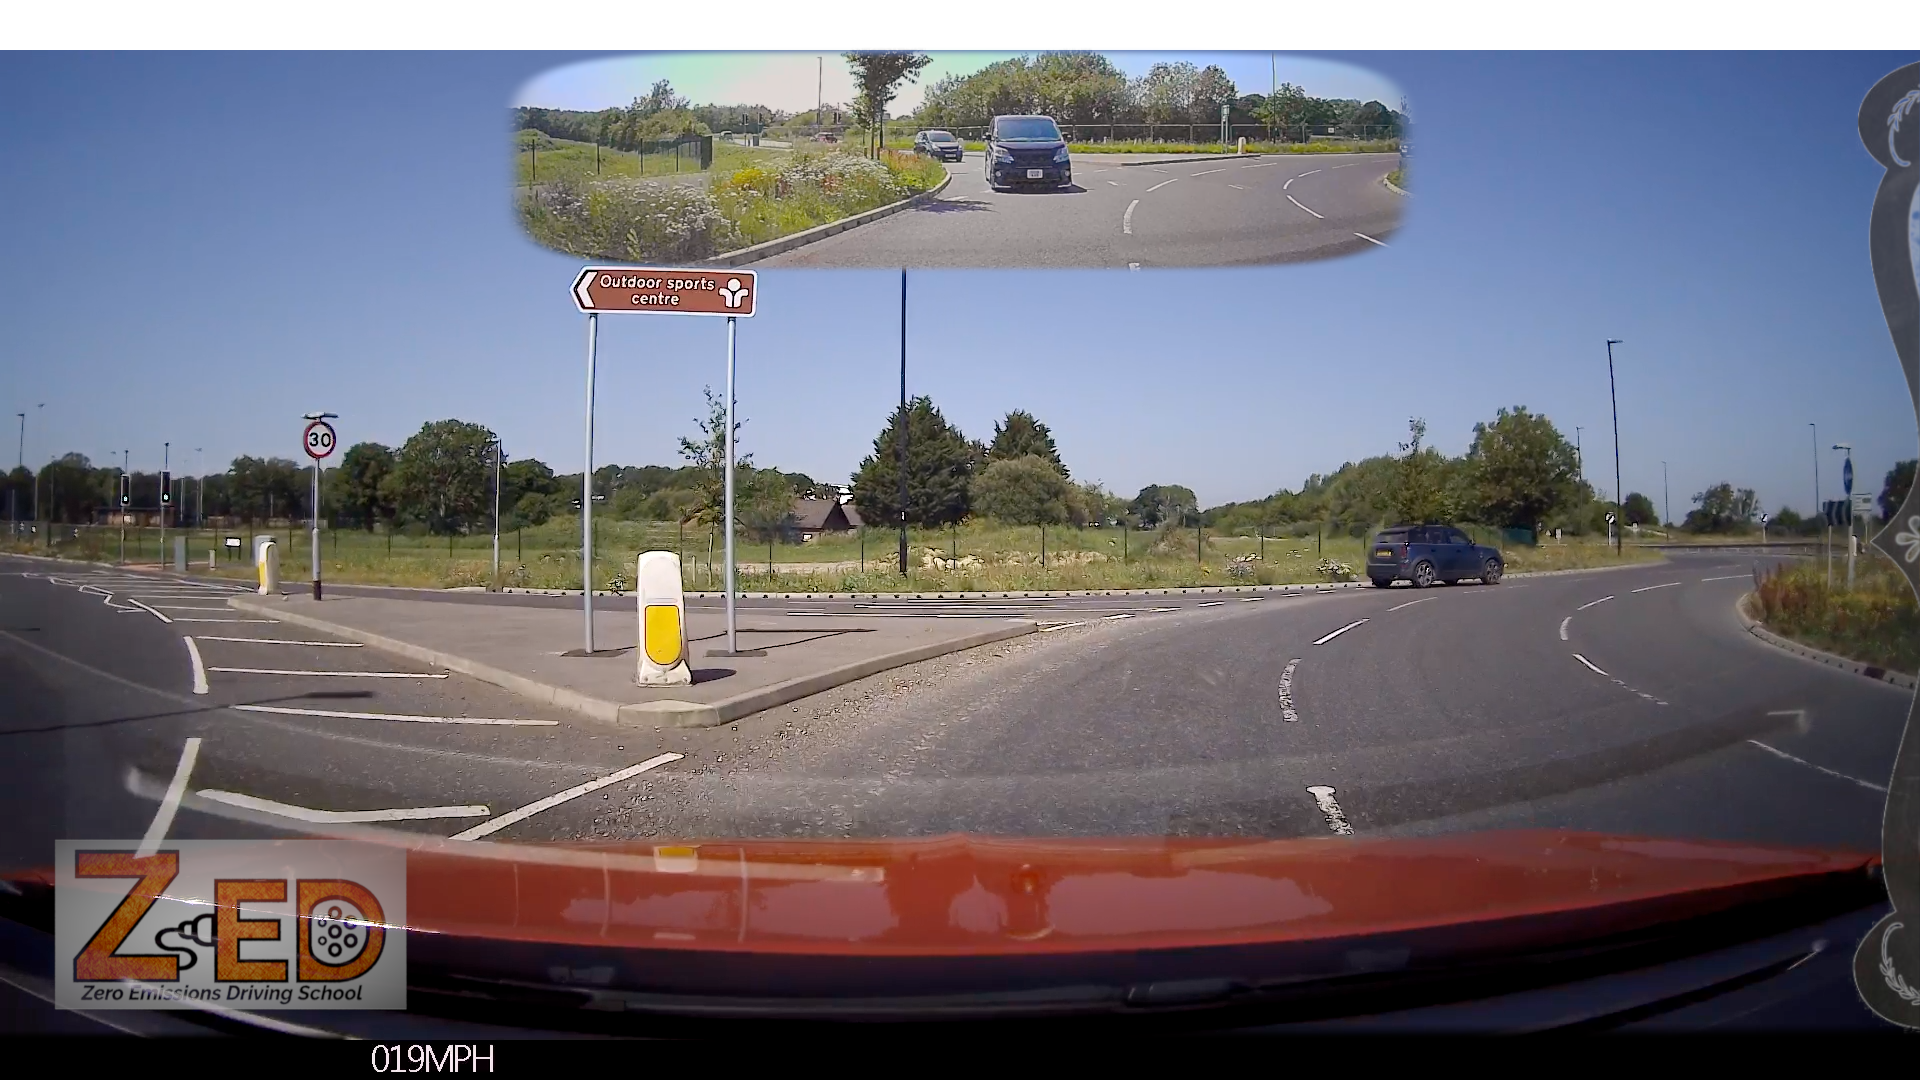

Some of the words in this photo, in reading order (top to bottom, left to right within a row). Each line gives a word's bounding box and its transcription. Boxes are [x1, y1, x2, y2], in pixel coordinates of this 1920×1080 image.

[600, 274, 661, 289] Outdoor
[666, 277, 716, 292] sports
[631, 292, 680, 306] centre
[309, 432, 331, 447] 30
